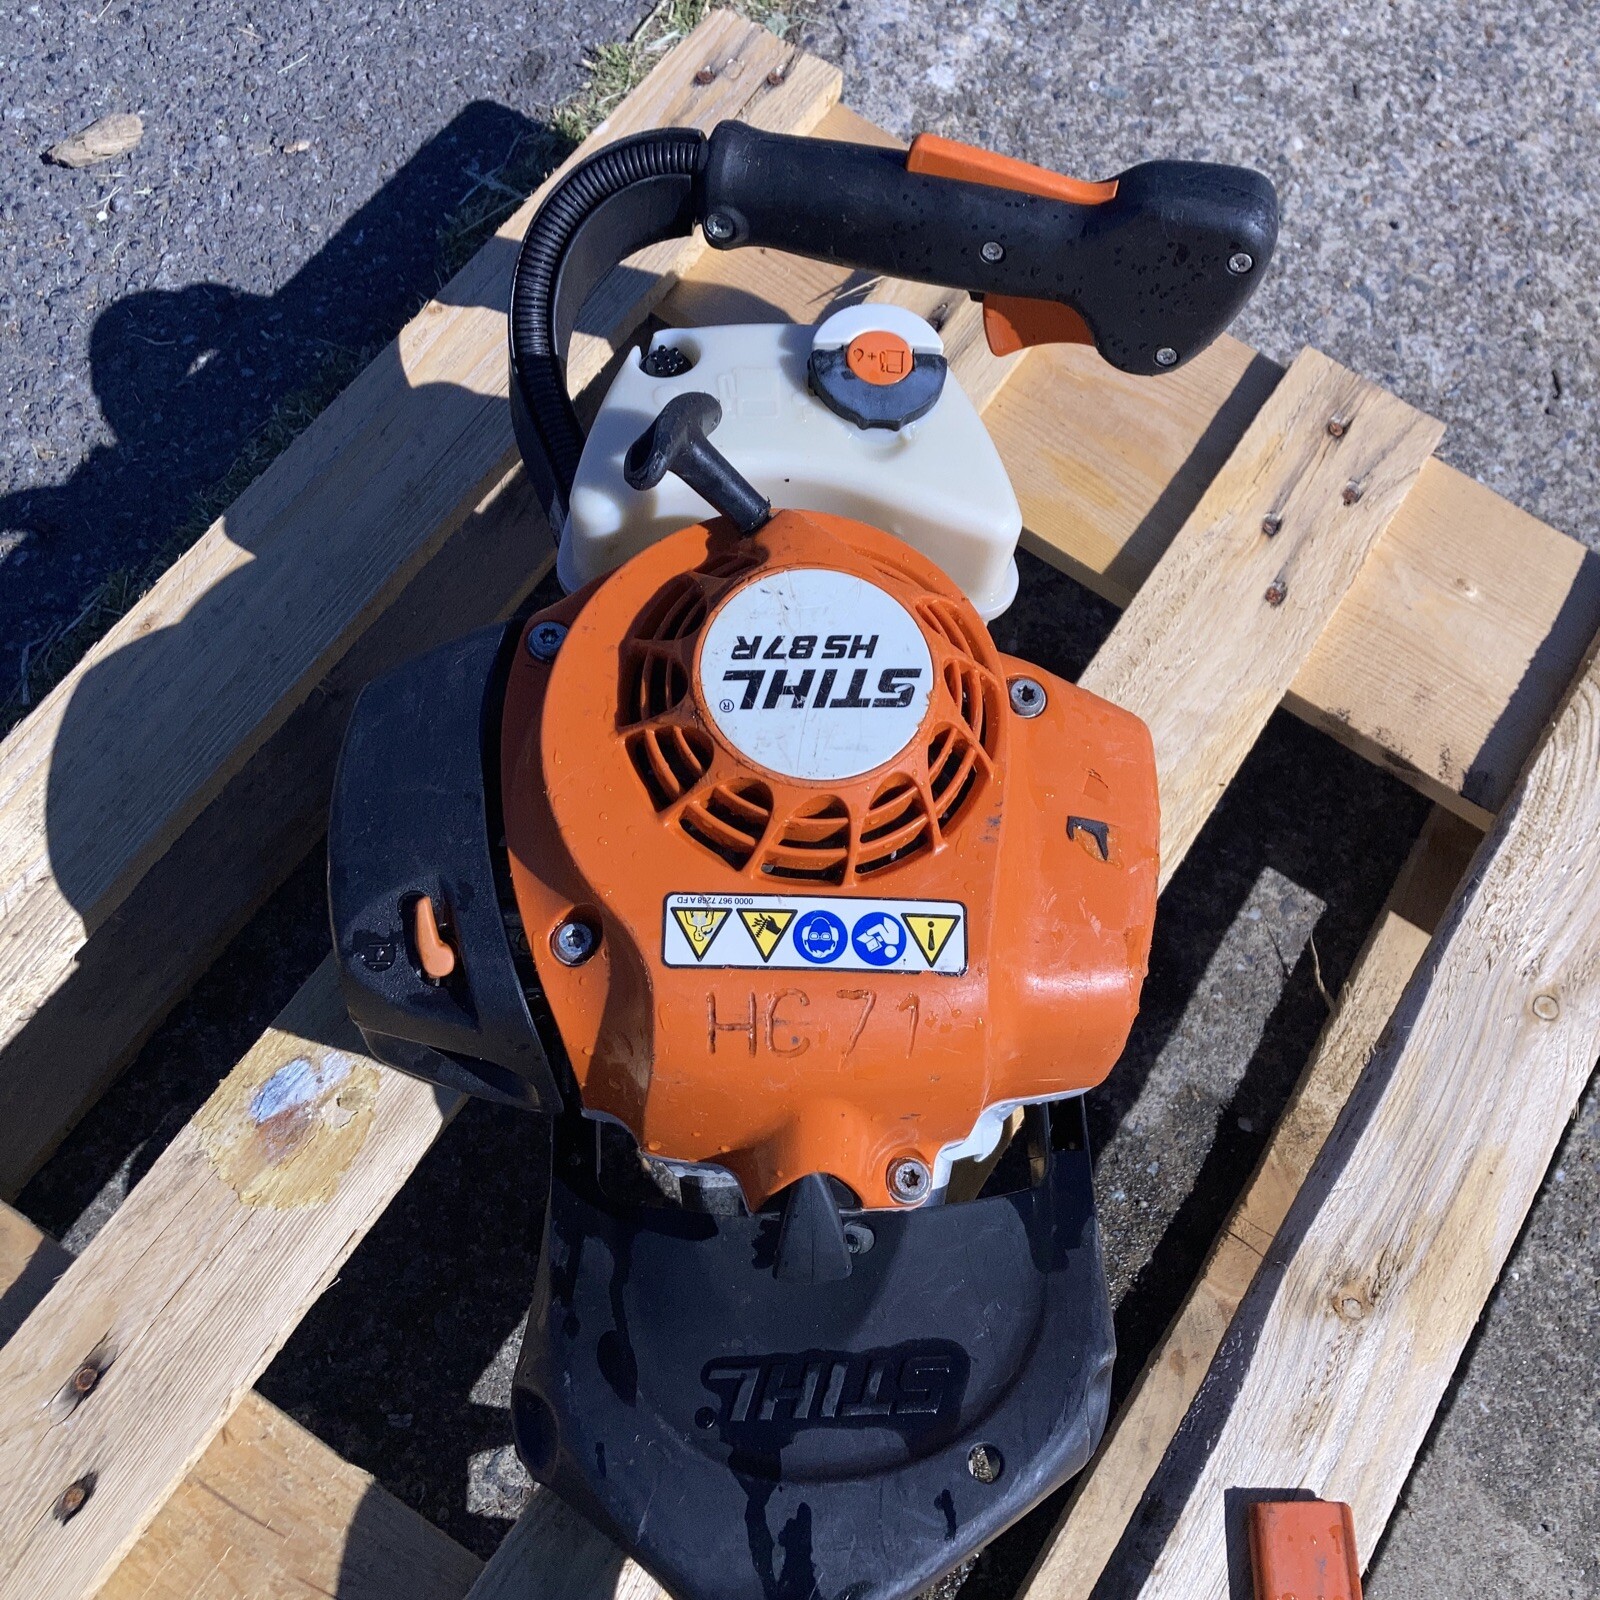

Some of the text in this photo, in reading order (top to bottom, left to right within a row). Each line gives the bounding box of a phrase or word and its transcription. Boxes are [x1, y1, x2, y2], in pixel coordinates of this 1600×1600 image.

[730, 634, 879, 660] HS 87R
[722, 668, 923, 710] STIHL
[718, 897, 733, 905] 967
[734, 897, 754, 905] 0000
[707, 1355, 951, 1422] STIHL
